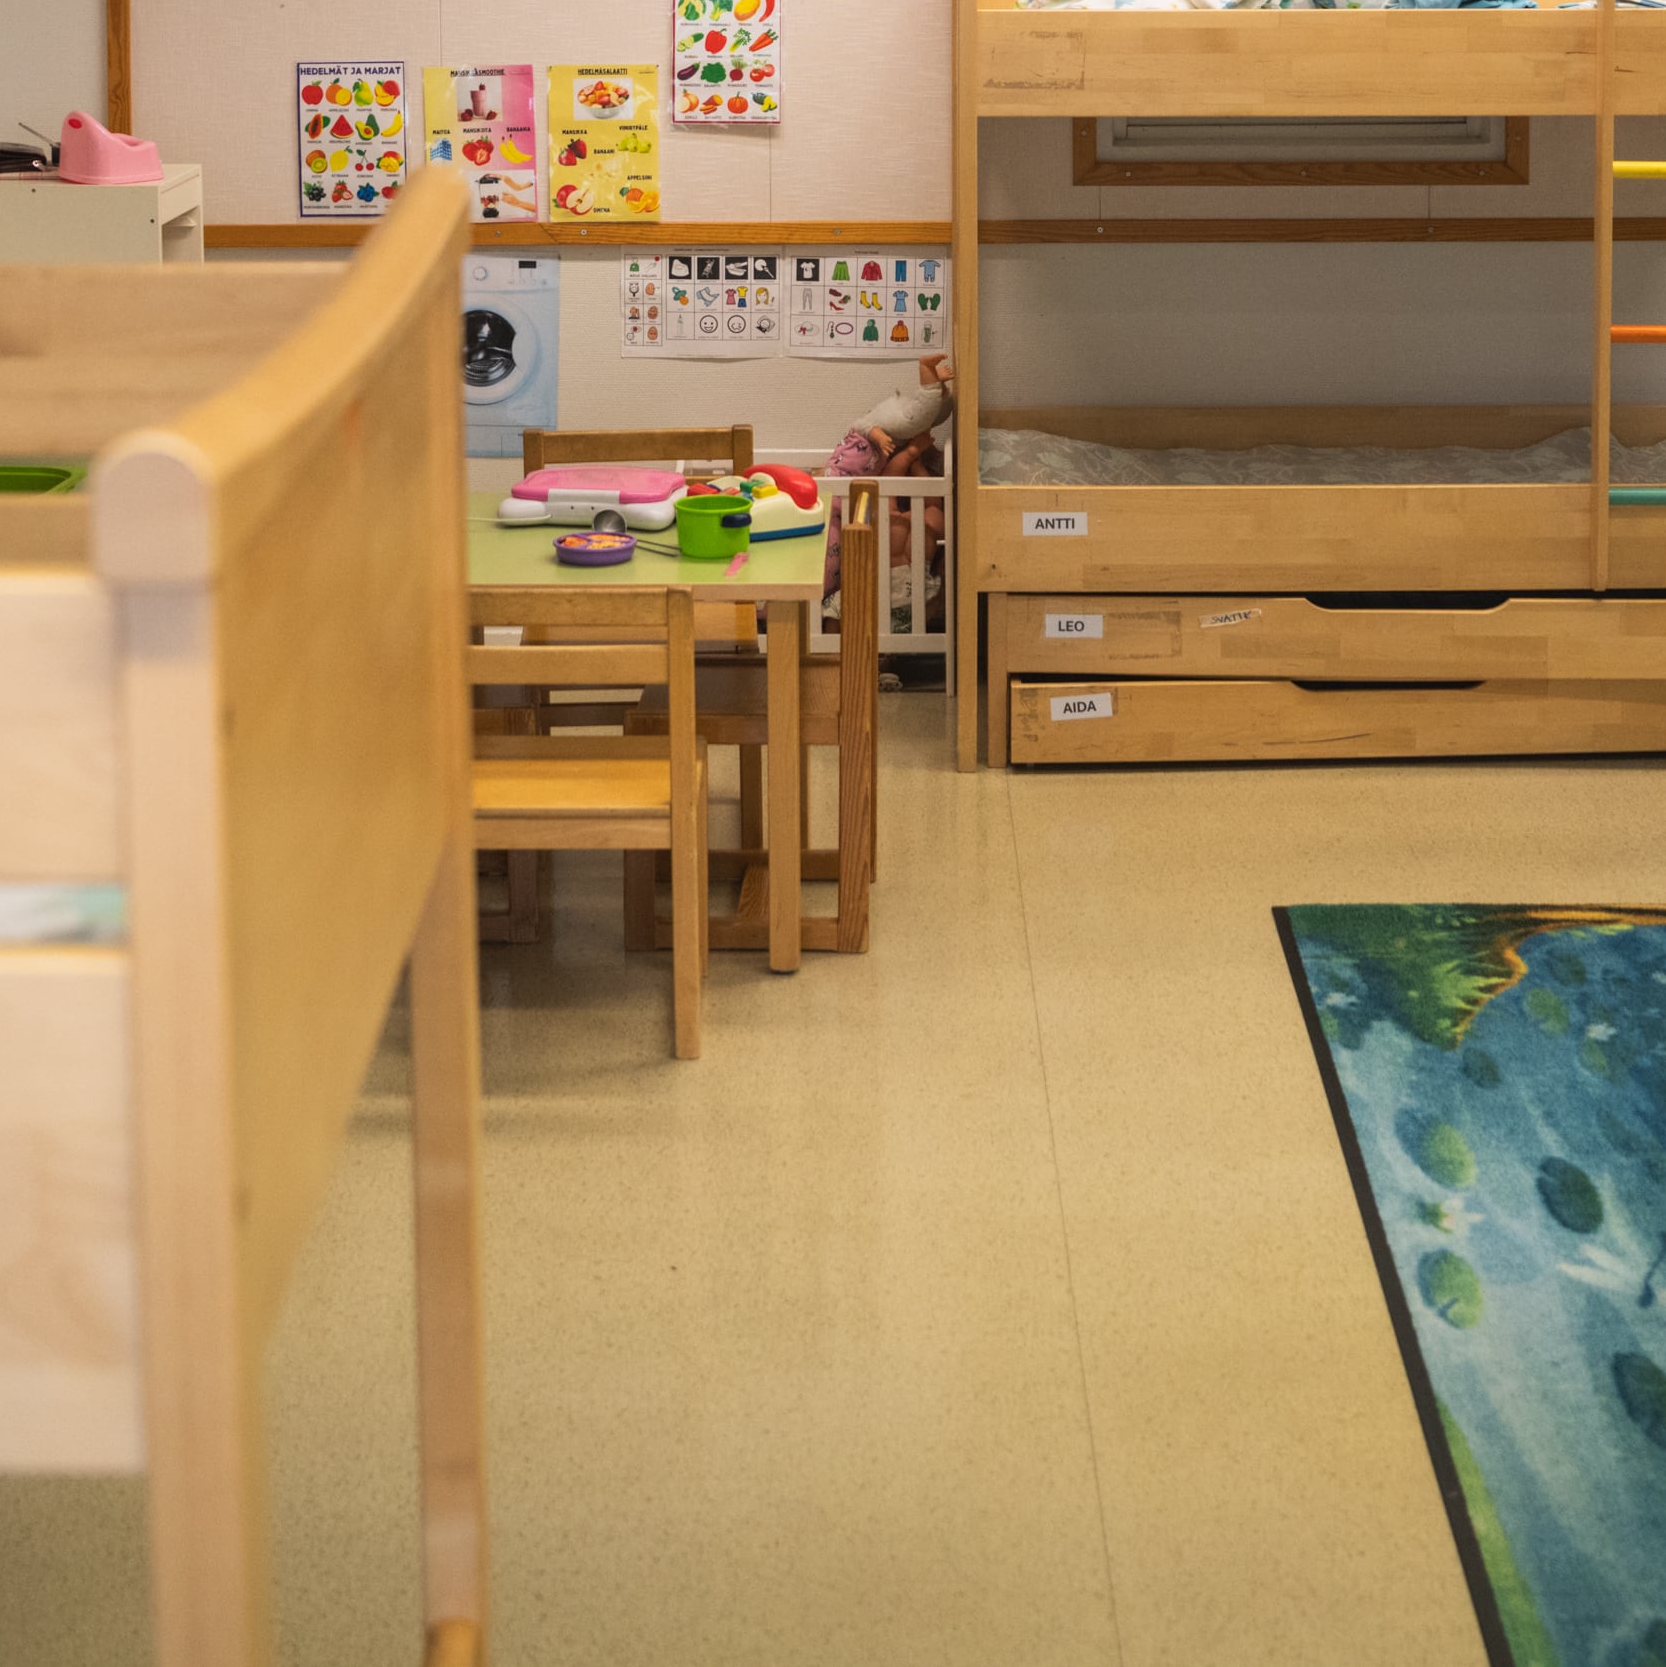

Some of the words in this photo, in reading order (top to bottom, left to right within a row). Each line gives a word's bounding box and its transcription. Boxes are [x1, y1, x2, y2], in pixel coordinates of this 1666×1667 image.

[300, 65, 348, 76] HEDELMÄT
[351, 66, 362, 75] JA
[364, 66, 402, 75] MARJAT
[1035, 517, 1076, 530] ANTTI
[1058, 620, 1085, 633] LEO
[1063, 701, 1097, 715] AIDA
